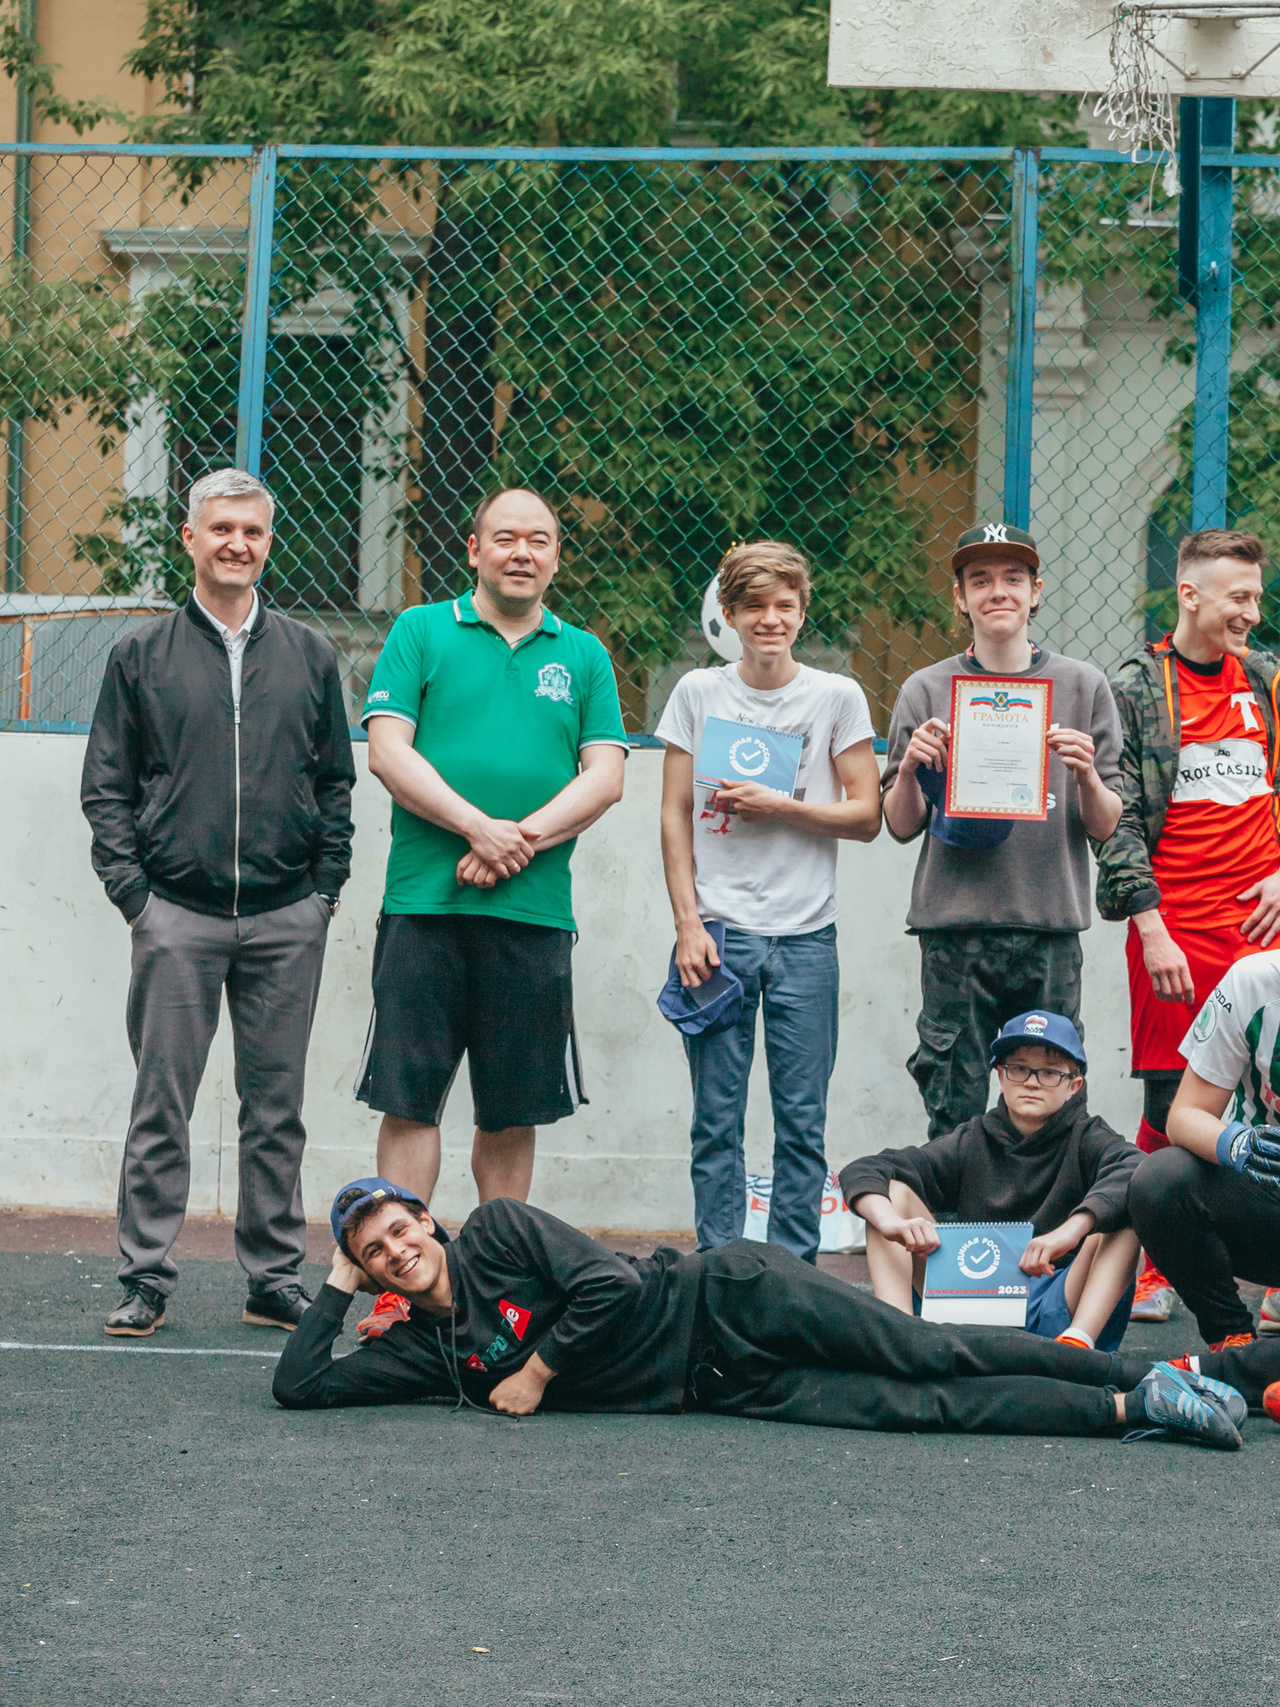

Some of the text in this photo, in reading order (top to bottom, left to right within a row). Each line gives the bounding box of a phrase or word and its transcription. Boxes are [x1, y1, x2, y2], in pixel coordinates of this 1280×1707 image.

[973, 712, 1029, 723] ГРАМОТА
[729, 737, 771, 768] ЕДИНАЯ РОССИЯ
[1214, 985, 1232, 1013] ODA
[957, 1237, 1001, 1267] ЕДИНАЯ РОССИЯ
[998, 1285, 1027, 1295] 2023
